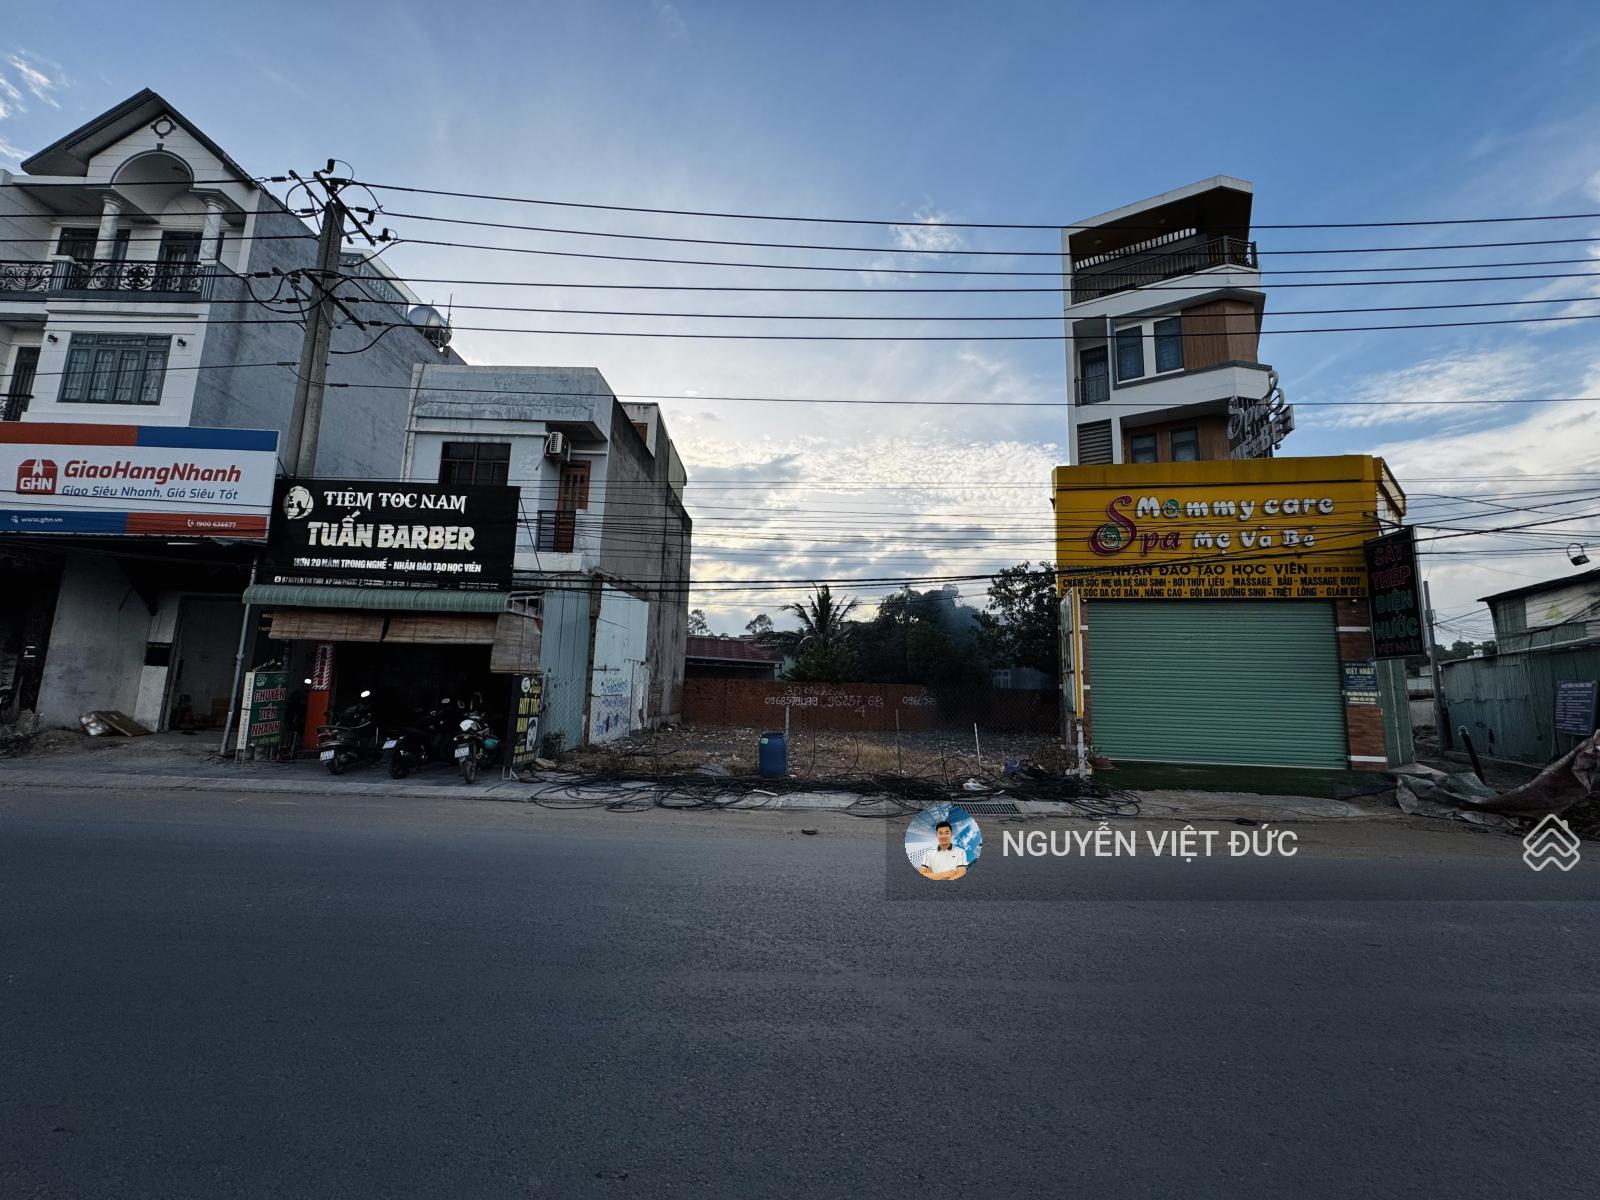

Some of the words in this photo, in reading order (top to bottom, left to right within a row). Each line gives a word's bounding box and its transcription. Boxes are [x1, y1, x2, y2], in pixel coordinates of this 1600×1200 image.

[64, 460, 241, 484] GiaoHangNhanh
[20, 476, 53, 491] GHN
[62, 486, 88, 496] Giao
[92, 486, 118, 497] Siêu
[166, 488, 186, 499] Giá
[190, 488, 214, 499] Siêu
[219, 488, 239, 500] Tốt
[323, 487, 374, 511] TIỆM
[420, 494, 468, 514] NAM
[1263, 498, 1335, 515] care
[306, 509, 375, 549] TUẤN
[377, 524, 476, 552] BARBER
[1089, 495, 1183, 557] Spa
[311, 558, 322, 567] 20
[340, 559, 366, 569] TRONG
[464, 561, 482, 574] VIÊN
[1231, 564, 1267, 578] HỌC
[1274, 562, 1308, 576] VIÊN
[1134, 577, 1147, 587] SAU
[1149, 577, 1166, 587] SINH
[1233, 577, 1272, 586] MASSAGE
[1300, 577, 1338, 586] MASSAGE
[1341, 576, 1361, 586] BODY
[1167, 588, 1183, 597] CAO
[1248, 587, 1266, 597] SINH
[251, 720, 281, 737] NHANH
